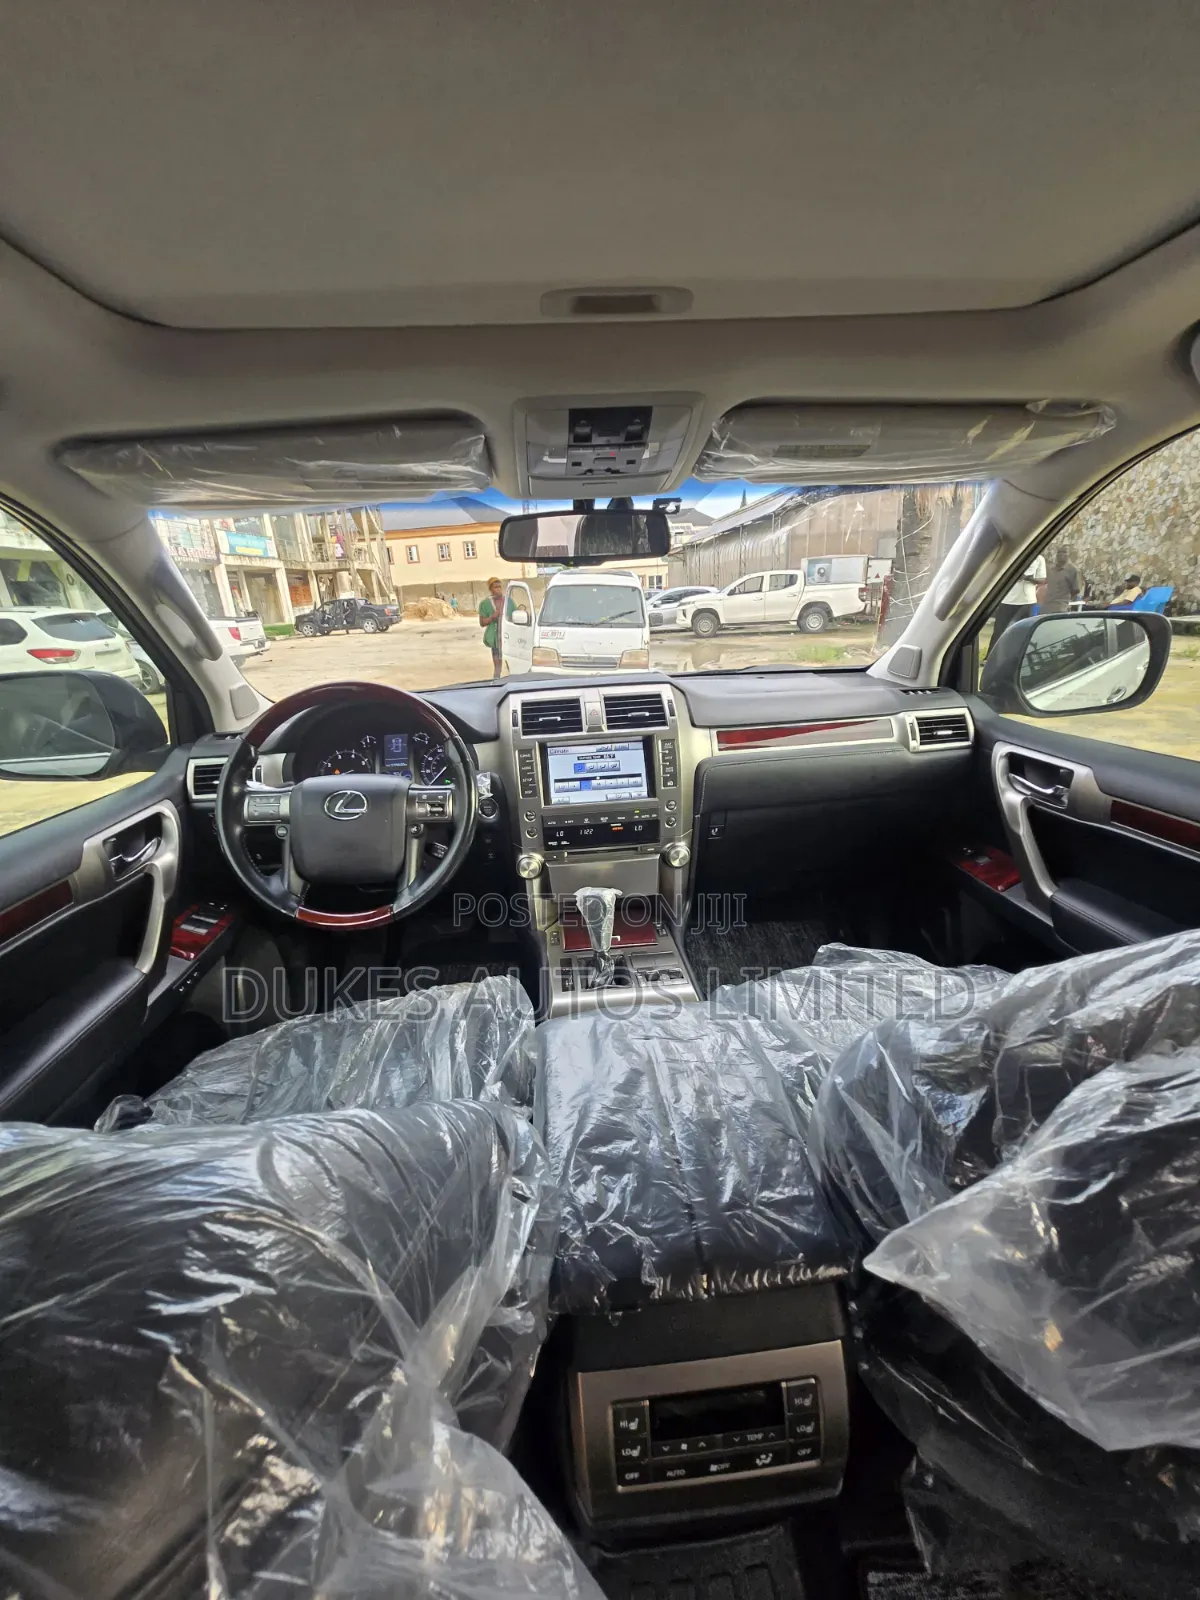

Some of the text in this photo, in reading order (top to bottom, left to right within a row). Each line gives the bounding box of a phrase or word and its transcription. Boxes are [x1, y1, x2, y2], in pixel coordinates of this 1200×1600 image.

[620, 1420, 628, 1429] HI
[746, 1432, 764, 1441] TEMP
[797, 1448, 812, 1456] OFF
[625, 1471, 640, 1480] OFF
[666, 1469, 686, 1477] AUTO
